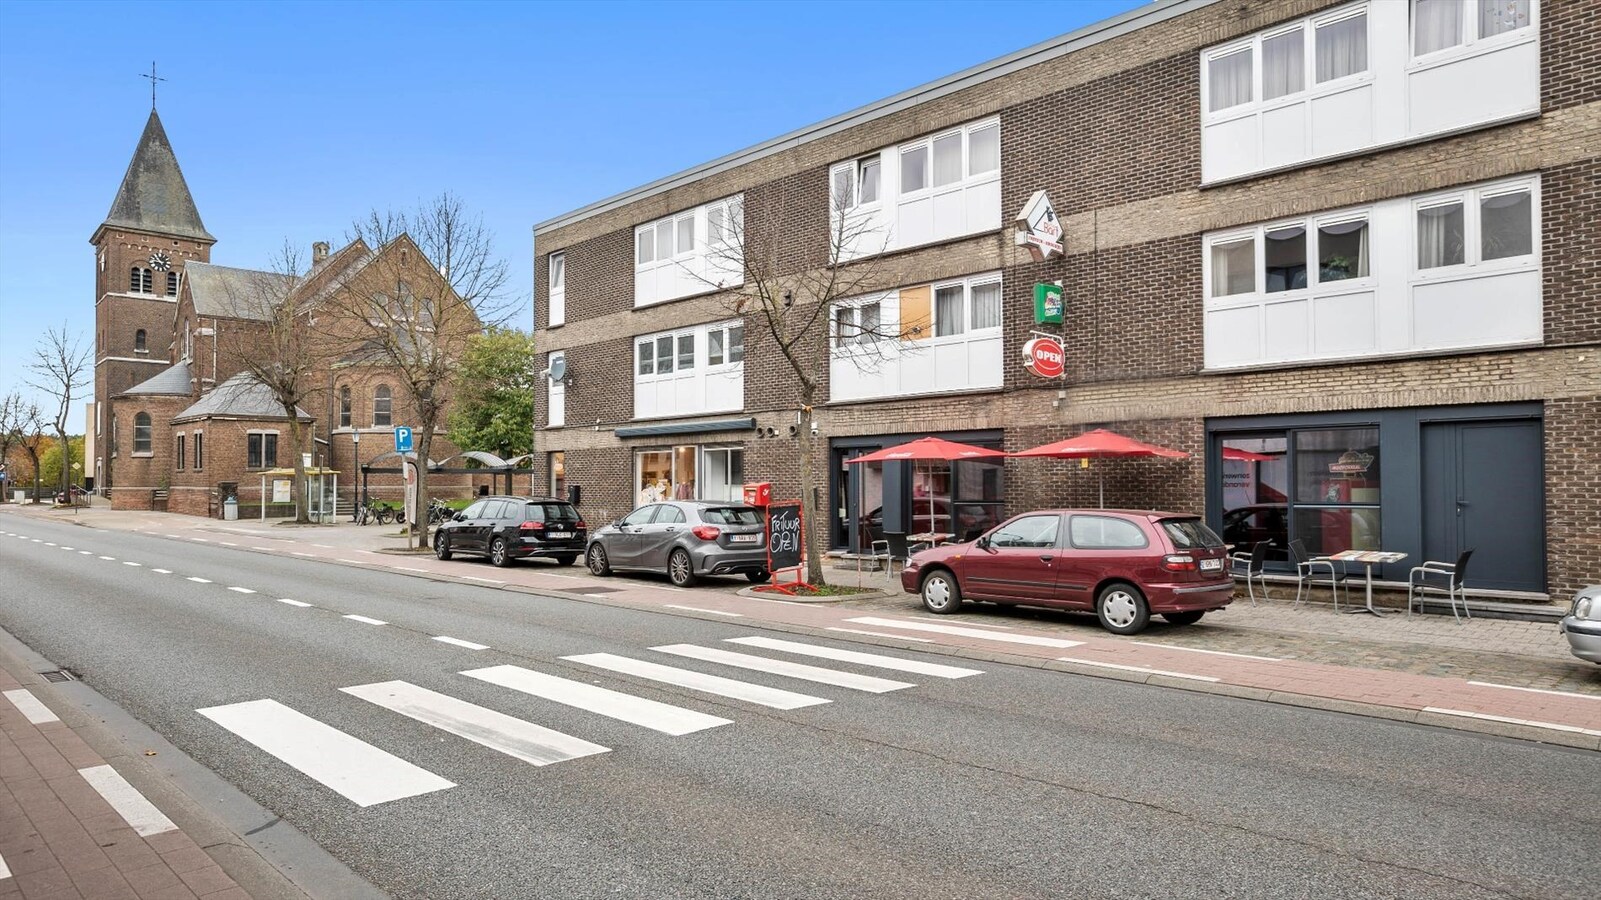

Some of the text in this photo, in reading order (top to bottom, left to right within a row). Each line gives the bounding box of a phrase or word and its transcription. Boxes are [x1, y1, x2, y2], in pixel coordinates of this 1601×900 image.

[1036, 349, 1062, 363] OPEN
[399, 429, 408, 443] P
[770, 530, 800, 553] OPEN
